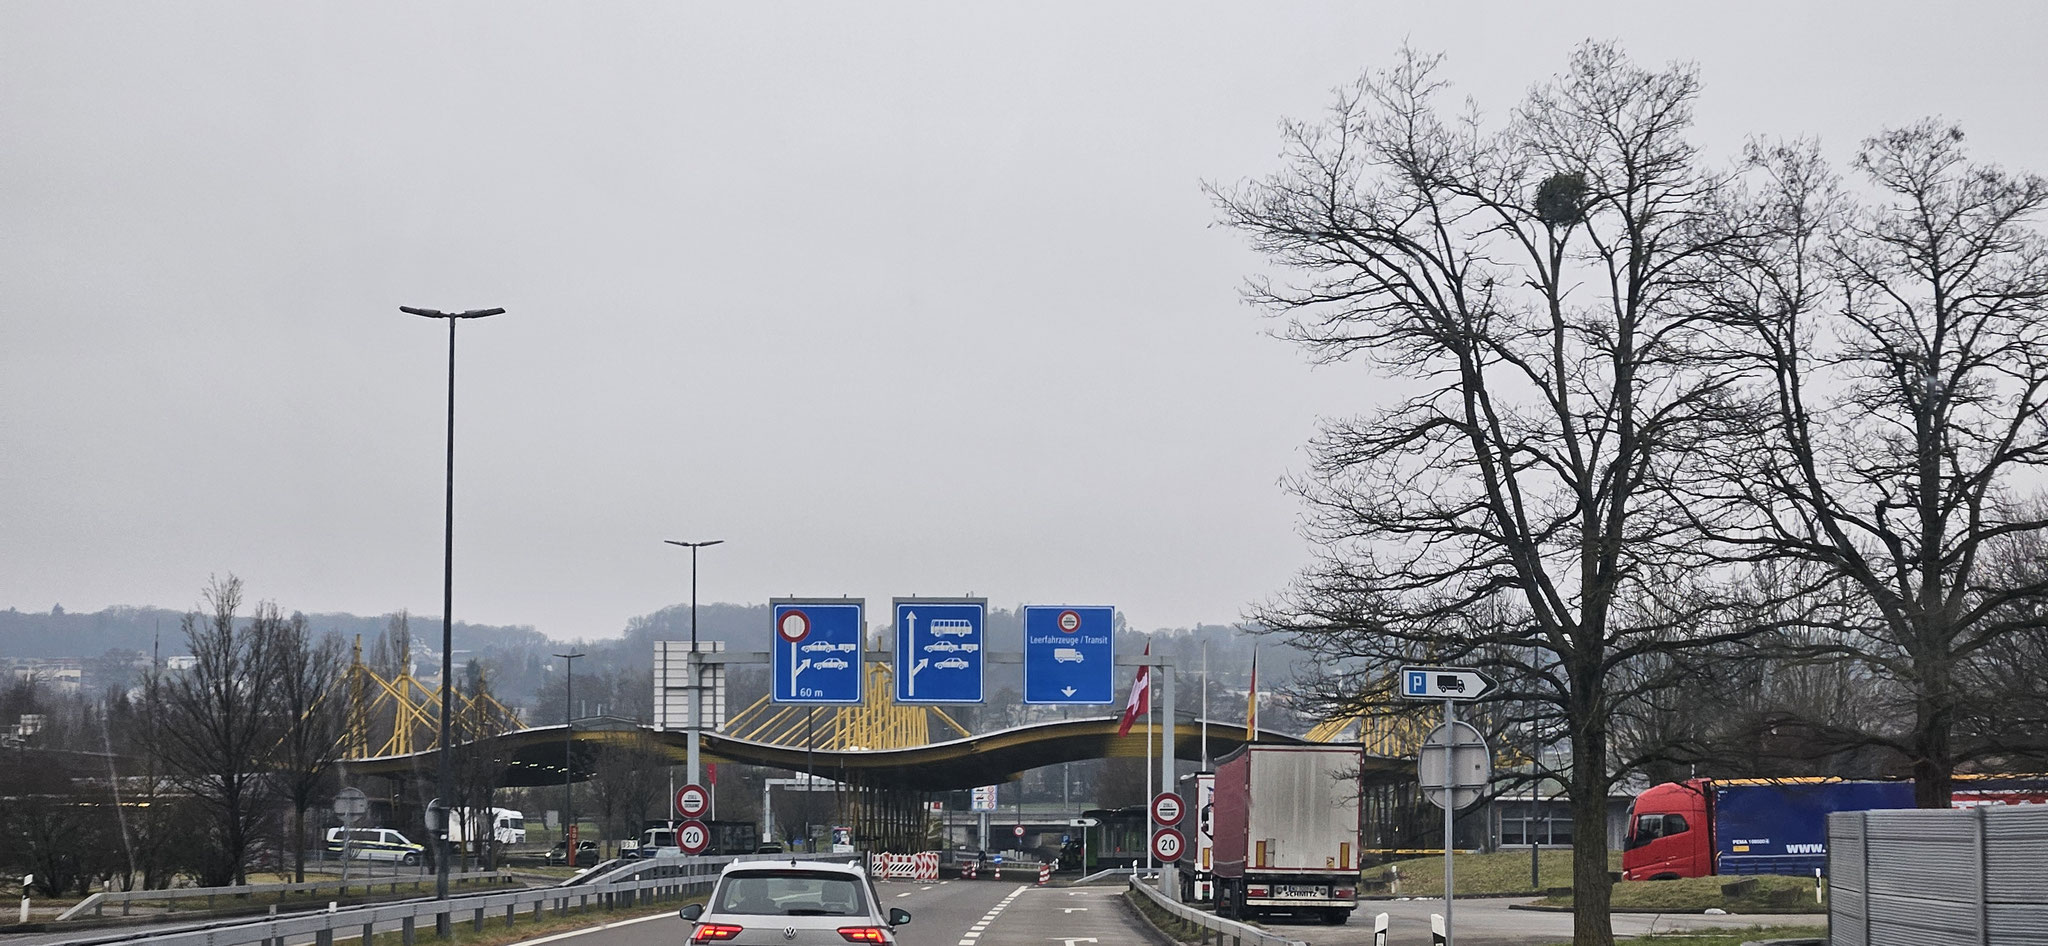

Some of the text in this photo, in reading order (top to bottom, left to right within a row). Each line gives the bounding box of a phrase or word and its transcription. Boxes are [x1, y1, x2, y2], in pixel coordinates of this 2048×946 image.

[1030, 635, 1079, 646] Leerfahrzeuge
[1084, 635, 1108, 644] Transit
[1413, 675, 1422, 691] P
[800, 687, 823, 697] 60 m
[685, 831, 699, 844] 20
[1161, 839, 1175, 851] 20
